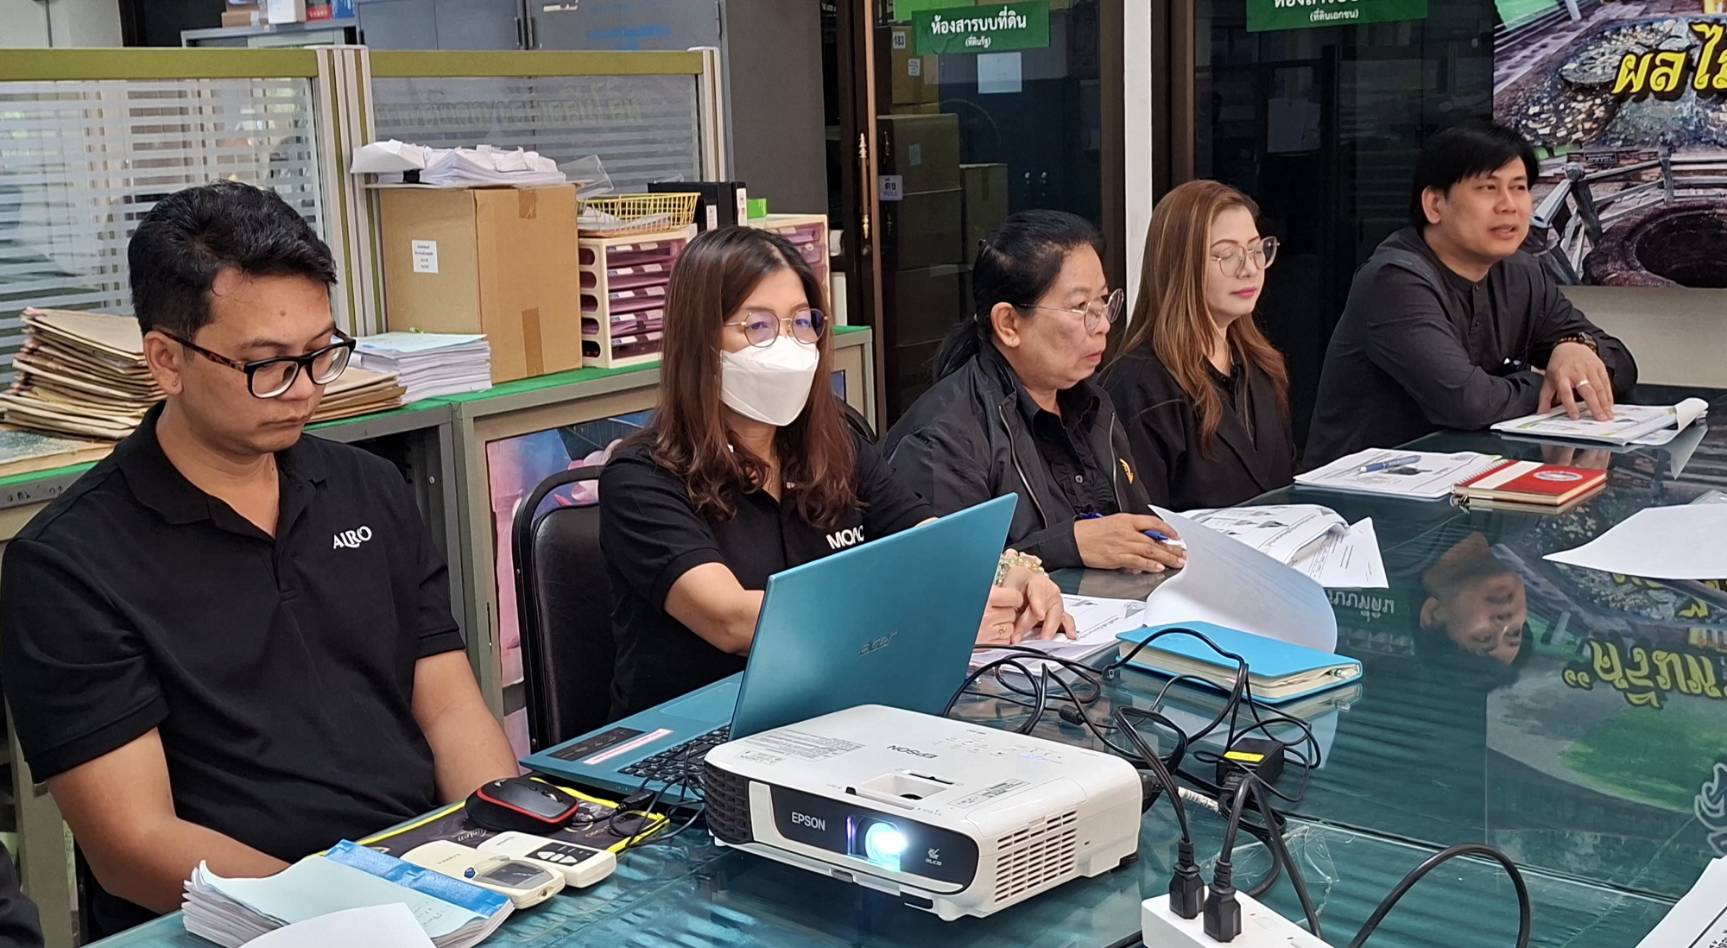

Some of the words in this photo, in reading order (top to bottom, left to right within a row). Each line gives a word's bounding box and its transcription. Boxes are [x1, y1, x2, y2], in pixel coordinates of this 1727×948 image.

[931, 5, 1027, 34] ห้องสารบบที่ดิน
[333, 525, 372, 549] ALRO
[887, 744, 938, 759] EPSON
[791, 811, 826, 832] EPSON
